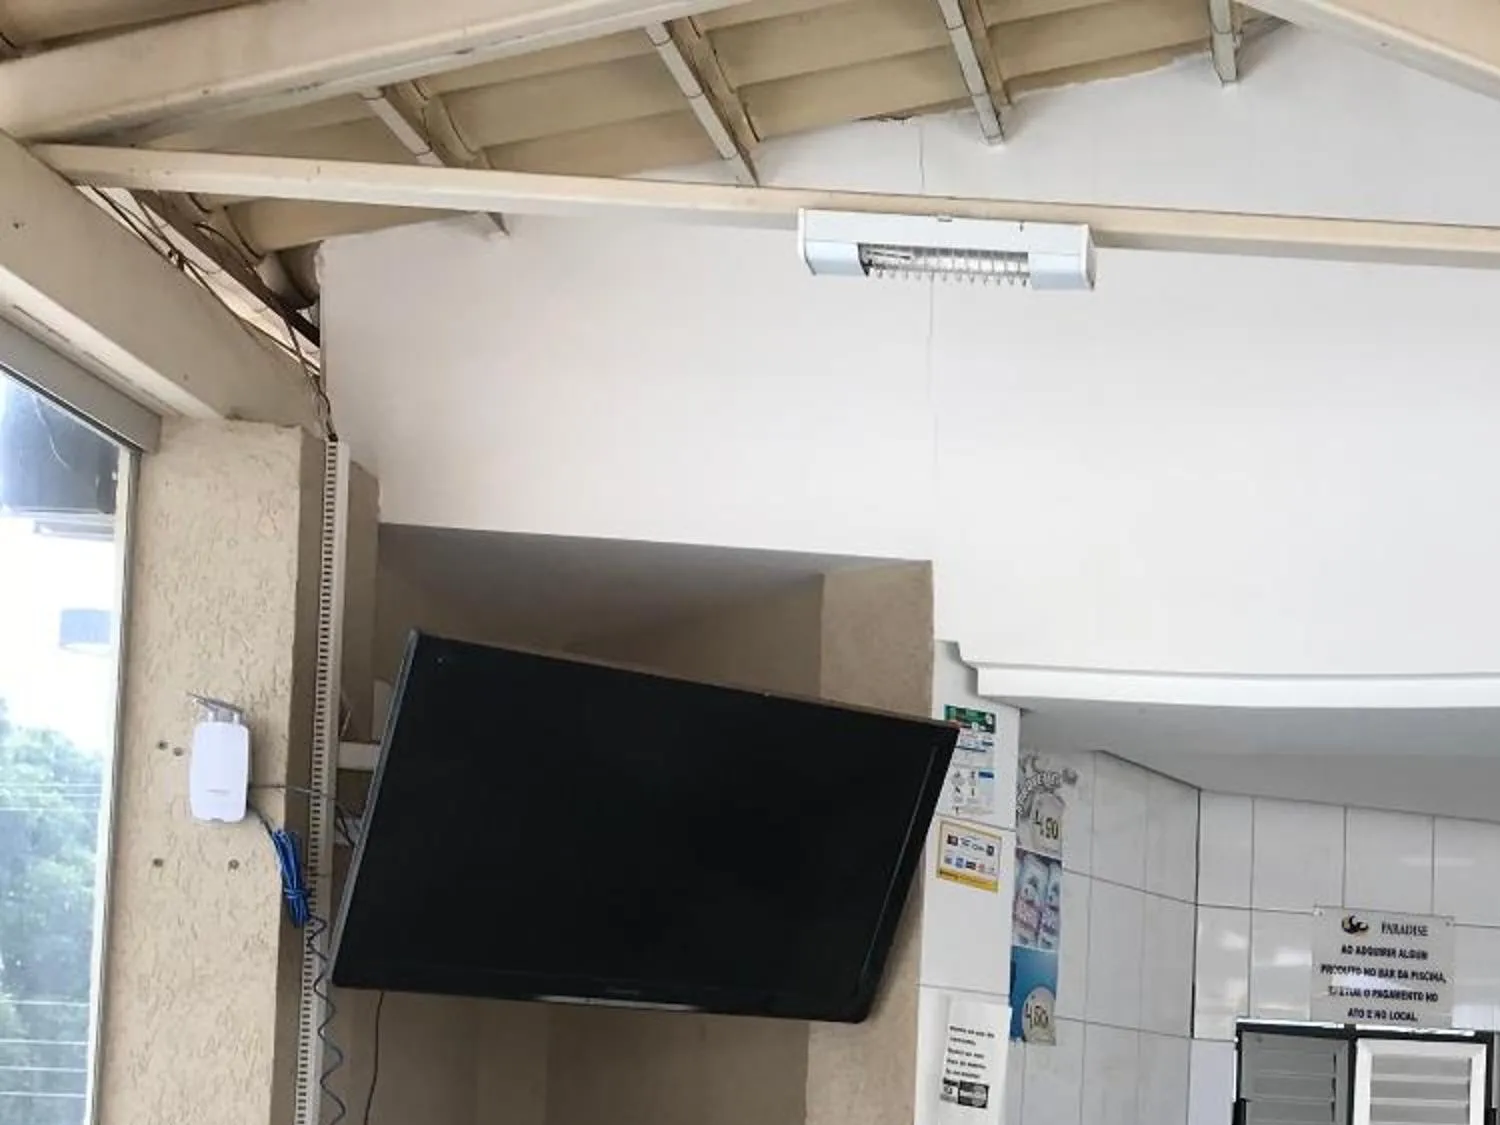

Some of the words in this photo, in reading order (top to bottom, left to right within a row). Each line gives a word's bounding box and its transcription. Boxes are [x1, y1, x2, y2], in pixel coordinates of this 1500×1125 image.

[1381, 922, 1429, 936] PARADISE
[1364, 967, 1376, 977] NO
[1378, 968, 1396, 979] BAR
